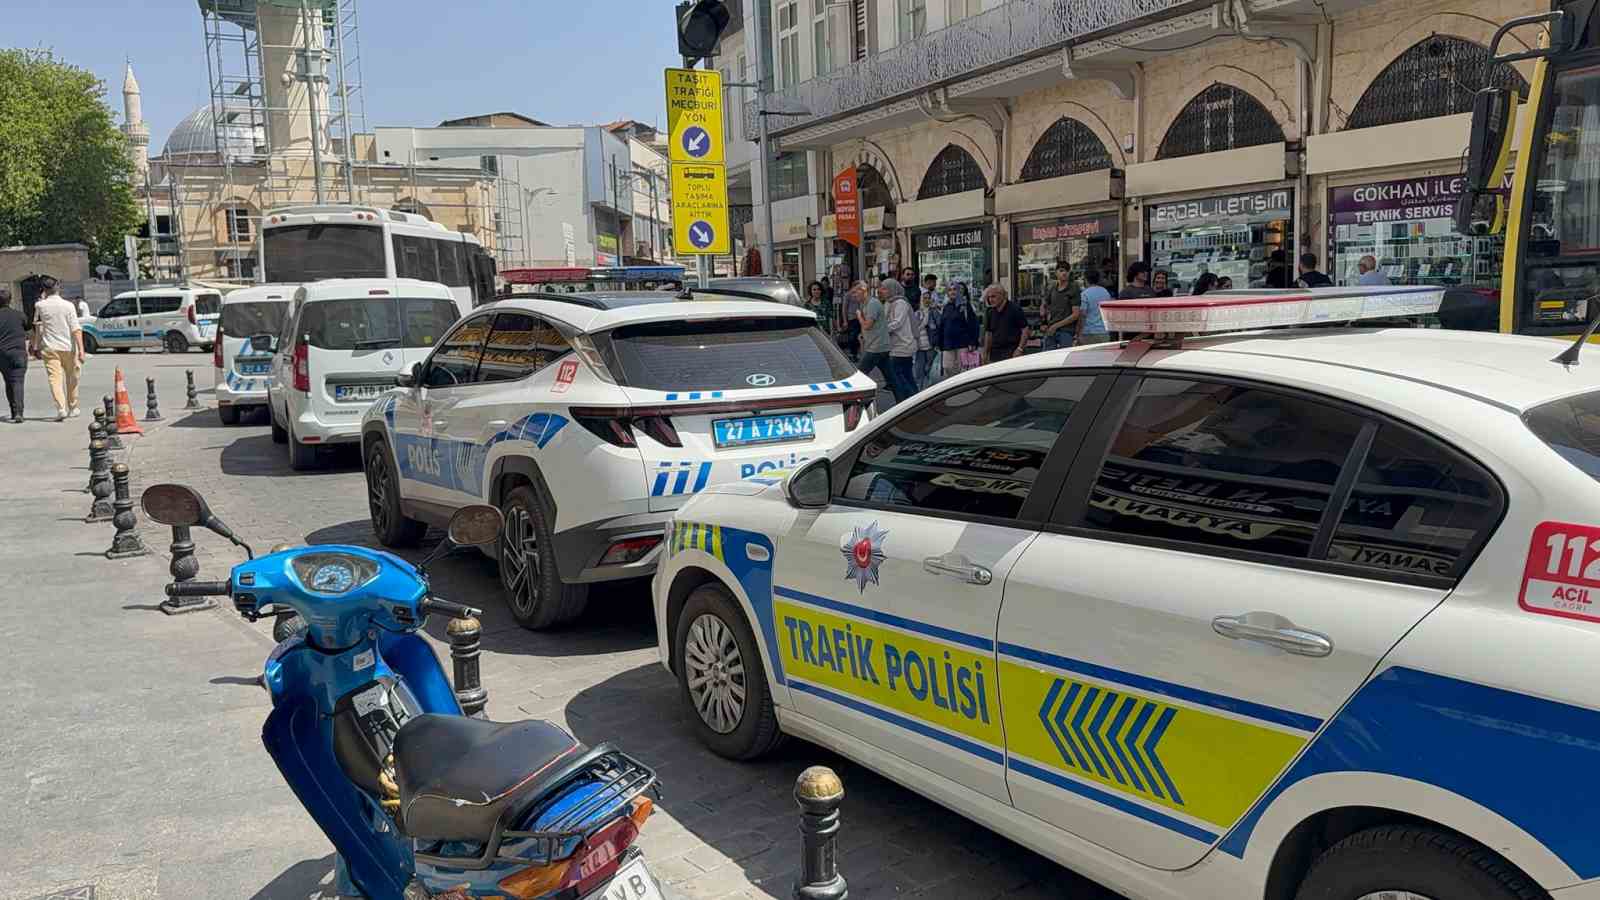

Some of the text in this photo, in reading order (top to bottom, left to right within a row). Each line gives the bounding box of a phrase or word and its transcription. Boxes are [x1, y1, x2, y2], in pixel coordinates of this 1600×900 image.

[1353, 180, 1429, 203] GÖKHAN
[1405, 204, 1454, 219] SERVİS
[724, 411, 813, 440] 27 A 73432
[407, 444, 441, 477] POLİS
[1546, 532, 1600, 581] 112
[784, 615, 991, 725] TRAFİK POLİSİ
